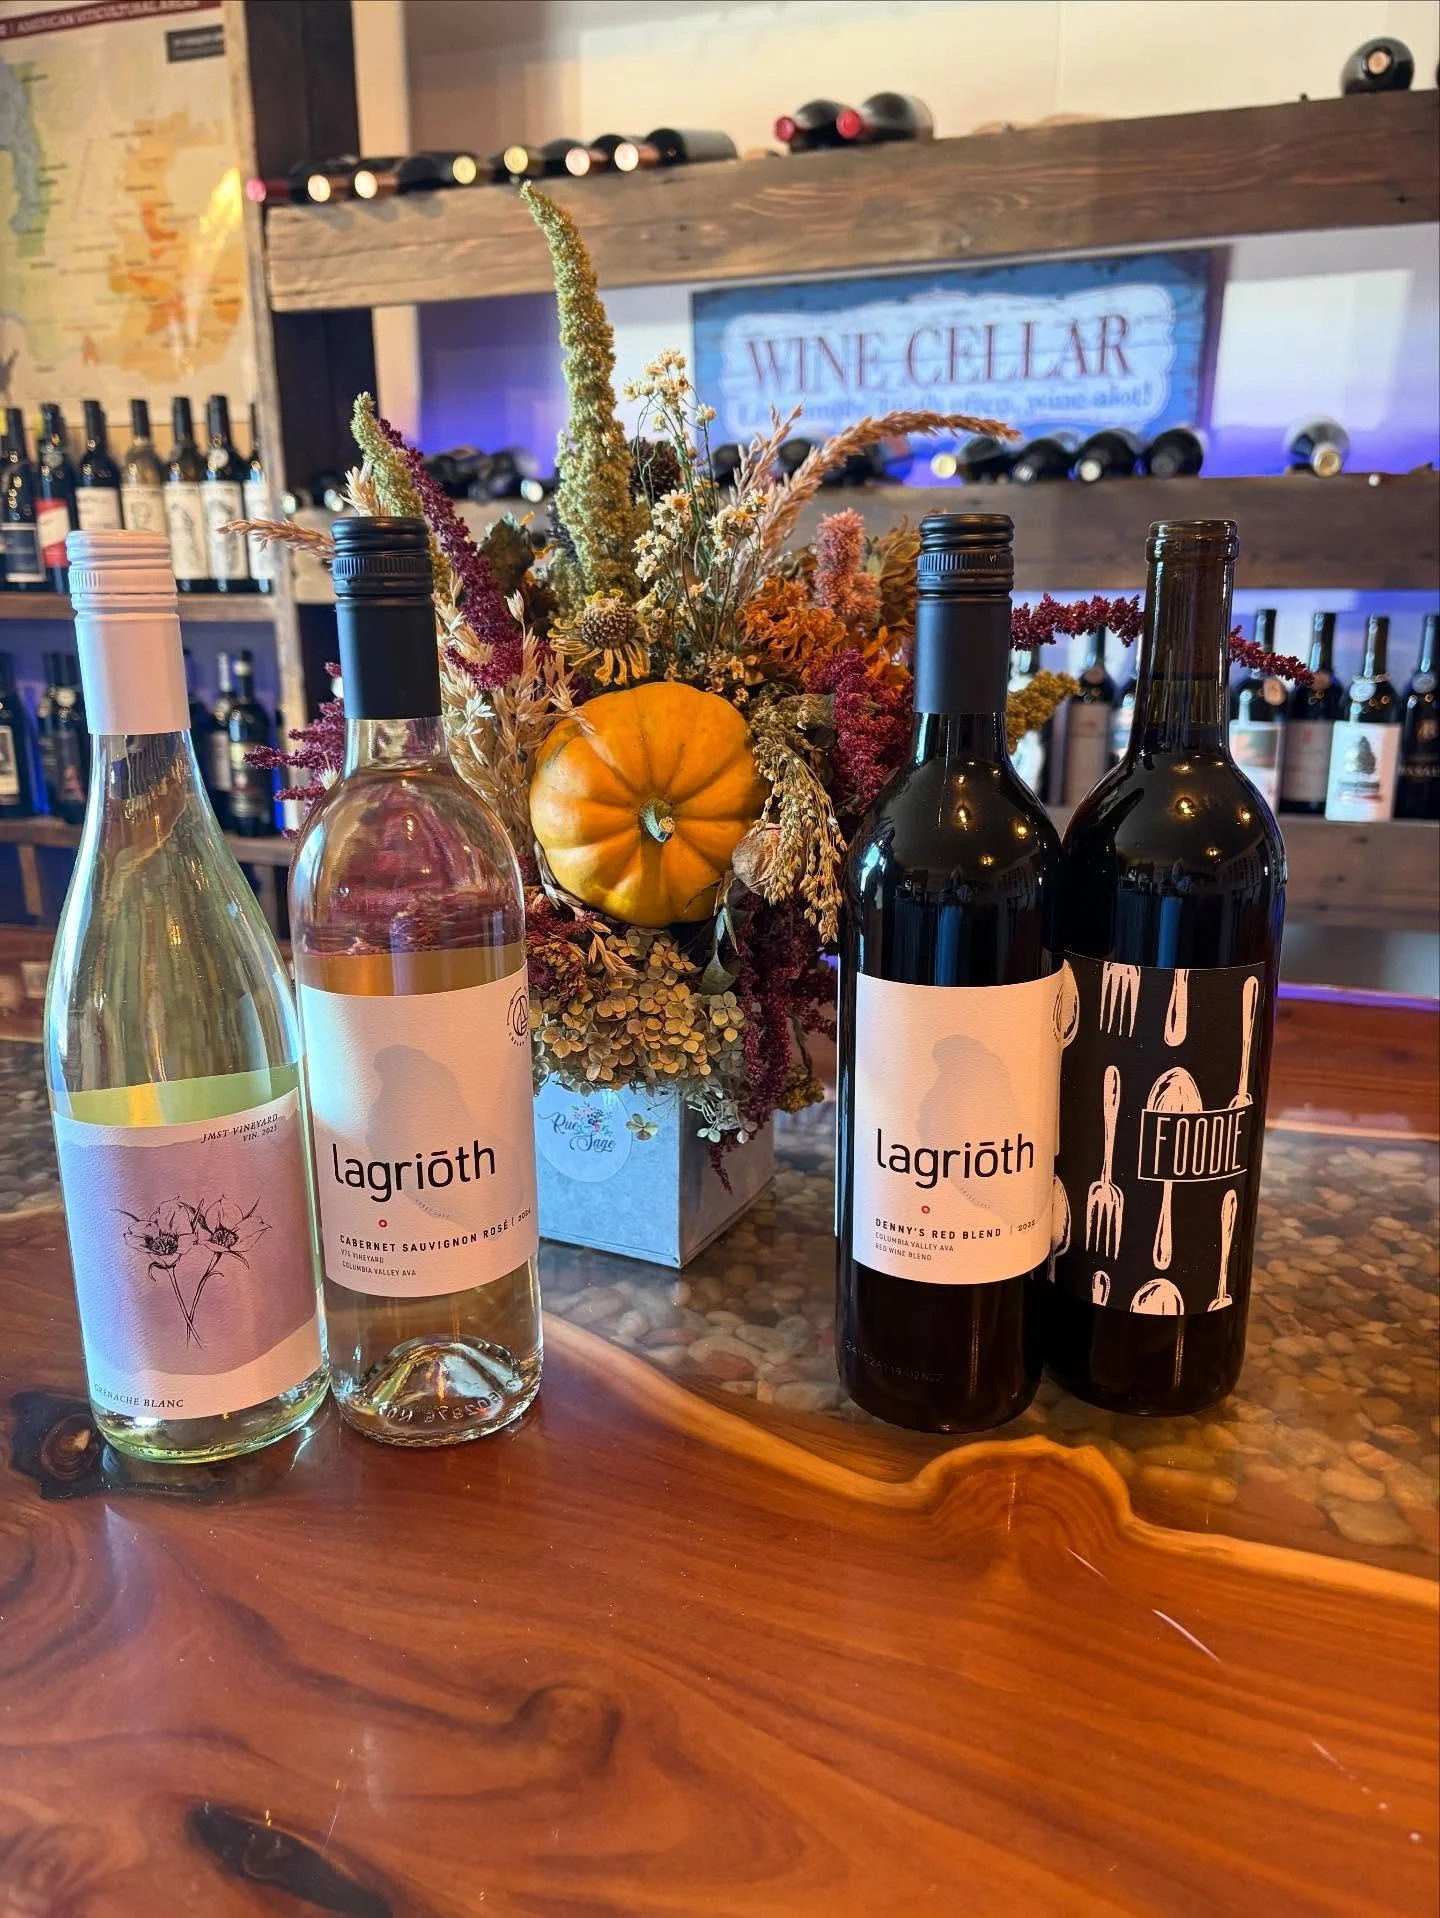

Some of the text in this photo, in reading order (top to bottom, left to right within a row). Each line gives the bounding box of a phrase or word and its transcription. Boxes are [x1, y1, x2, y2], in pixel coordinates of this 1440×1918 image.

[745, 313, 1132, 393] WINE CELLAR
[201, 1113, 279, 1144] JMST VINEYARD
[569, 1130, 617, 1153] Sage
[1153, 1110, 1246, 1176] FOODIE
[877, 1128, 1034, 1189] lagriōth
[332, 1140, 496, 1203] lagriōth
[339, 1234, 396, 1253] CABERNET
[402, 1233, 477, 1252] SAUVIGNON
[482, 1219, 508, 1239] ROSÉ
[875, 1218, 925, 1237] DENNY'S
[931, 1230, 956, 1240] RED
[962, 1228, 1001, 1240] BLEND
[875, 1231, 954, 1252] COLUMBIA VALLEY AVA
[353, 1252, 384, 1264] VINEYARD
[888, 1247, 906, 1257] WINE
[908, 1251, 932, 1261] BLEND
[342, 1260, 417, 1277] COLUMBIA VALLEY AVA
[94, 1383, 184, 1408] GRENACHE BLANC
